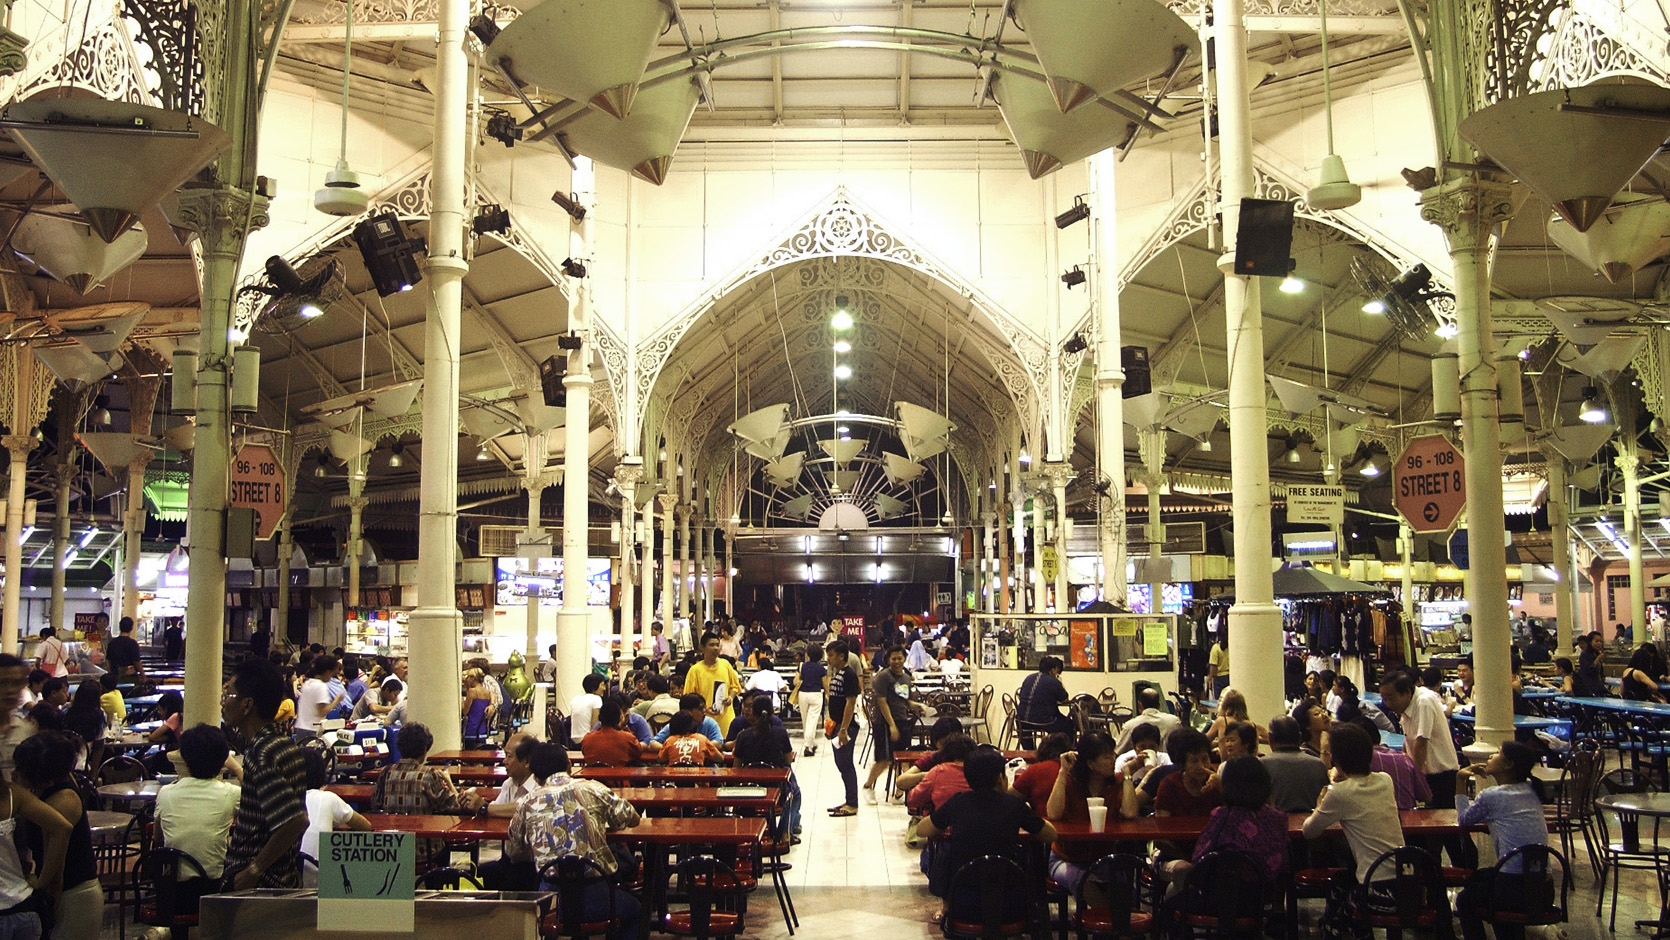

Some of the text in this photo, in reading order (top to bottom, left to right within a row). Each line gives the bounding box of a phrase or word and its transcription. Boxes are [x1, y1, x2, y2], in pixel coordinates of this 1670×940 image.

[1407, 455, 1422, 469] 96
[1434, 451, 1454, 465] 108
[237, 461, 250, 474] 96
[259, 463, 275, 476] 108
[1401, 470, 1462, 498] STREET 8
[232, 481, 281, 503] STREET 8
[1289, 488, 1342, 497] FREE SEATING
[76, 615, 95, 623] TAKE
[844, 617, 863, 626] TAKE
[330, 833, 405, 848] CUTLERY
[331, 848, 397, 862] STATION
